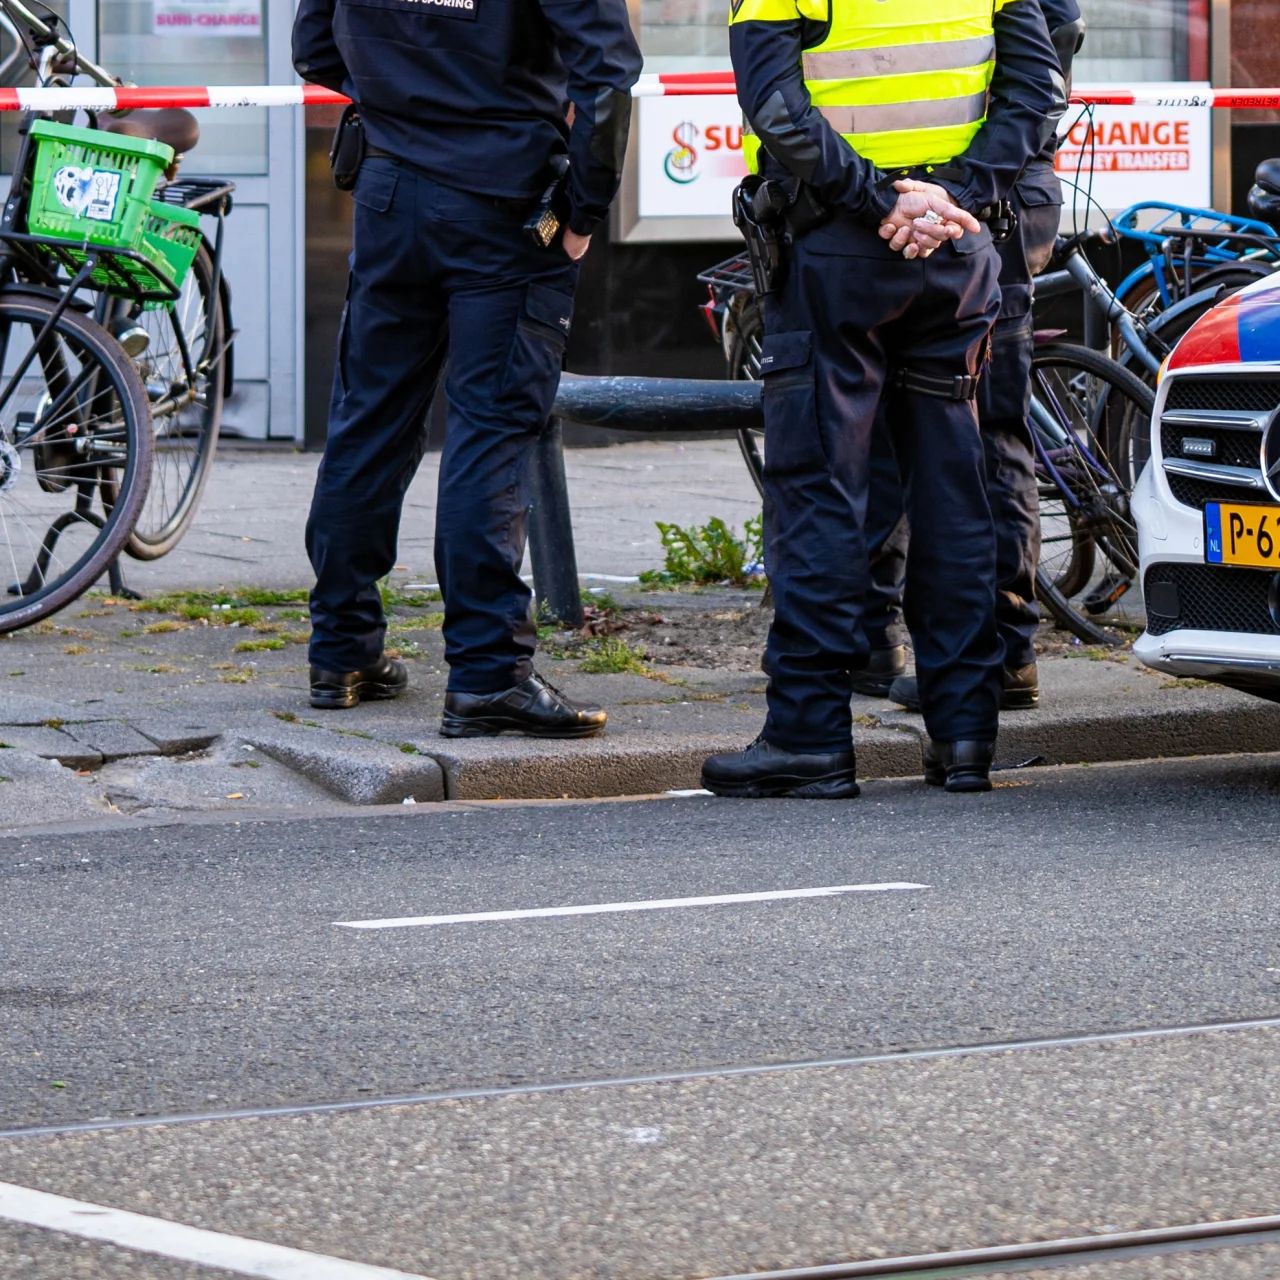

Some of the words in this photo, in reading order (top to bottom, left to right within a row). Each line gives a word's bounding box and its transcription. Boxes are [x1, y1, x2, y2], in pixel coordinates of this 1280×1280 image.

[156, 13, 260, 26] SURI-CHANGE
[1230, 97, 1279, 106] BETREDEN
[1068, 121, 1189, 145] CHANGE
[1115, 152, 1188, 170] TRANSFER
[1210, 539, 1221, 553] NL
